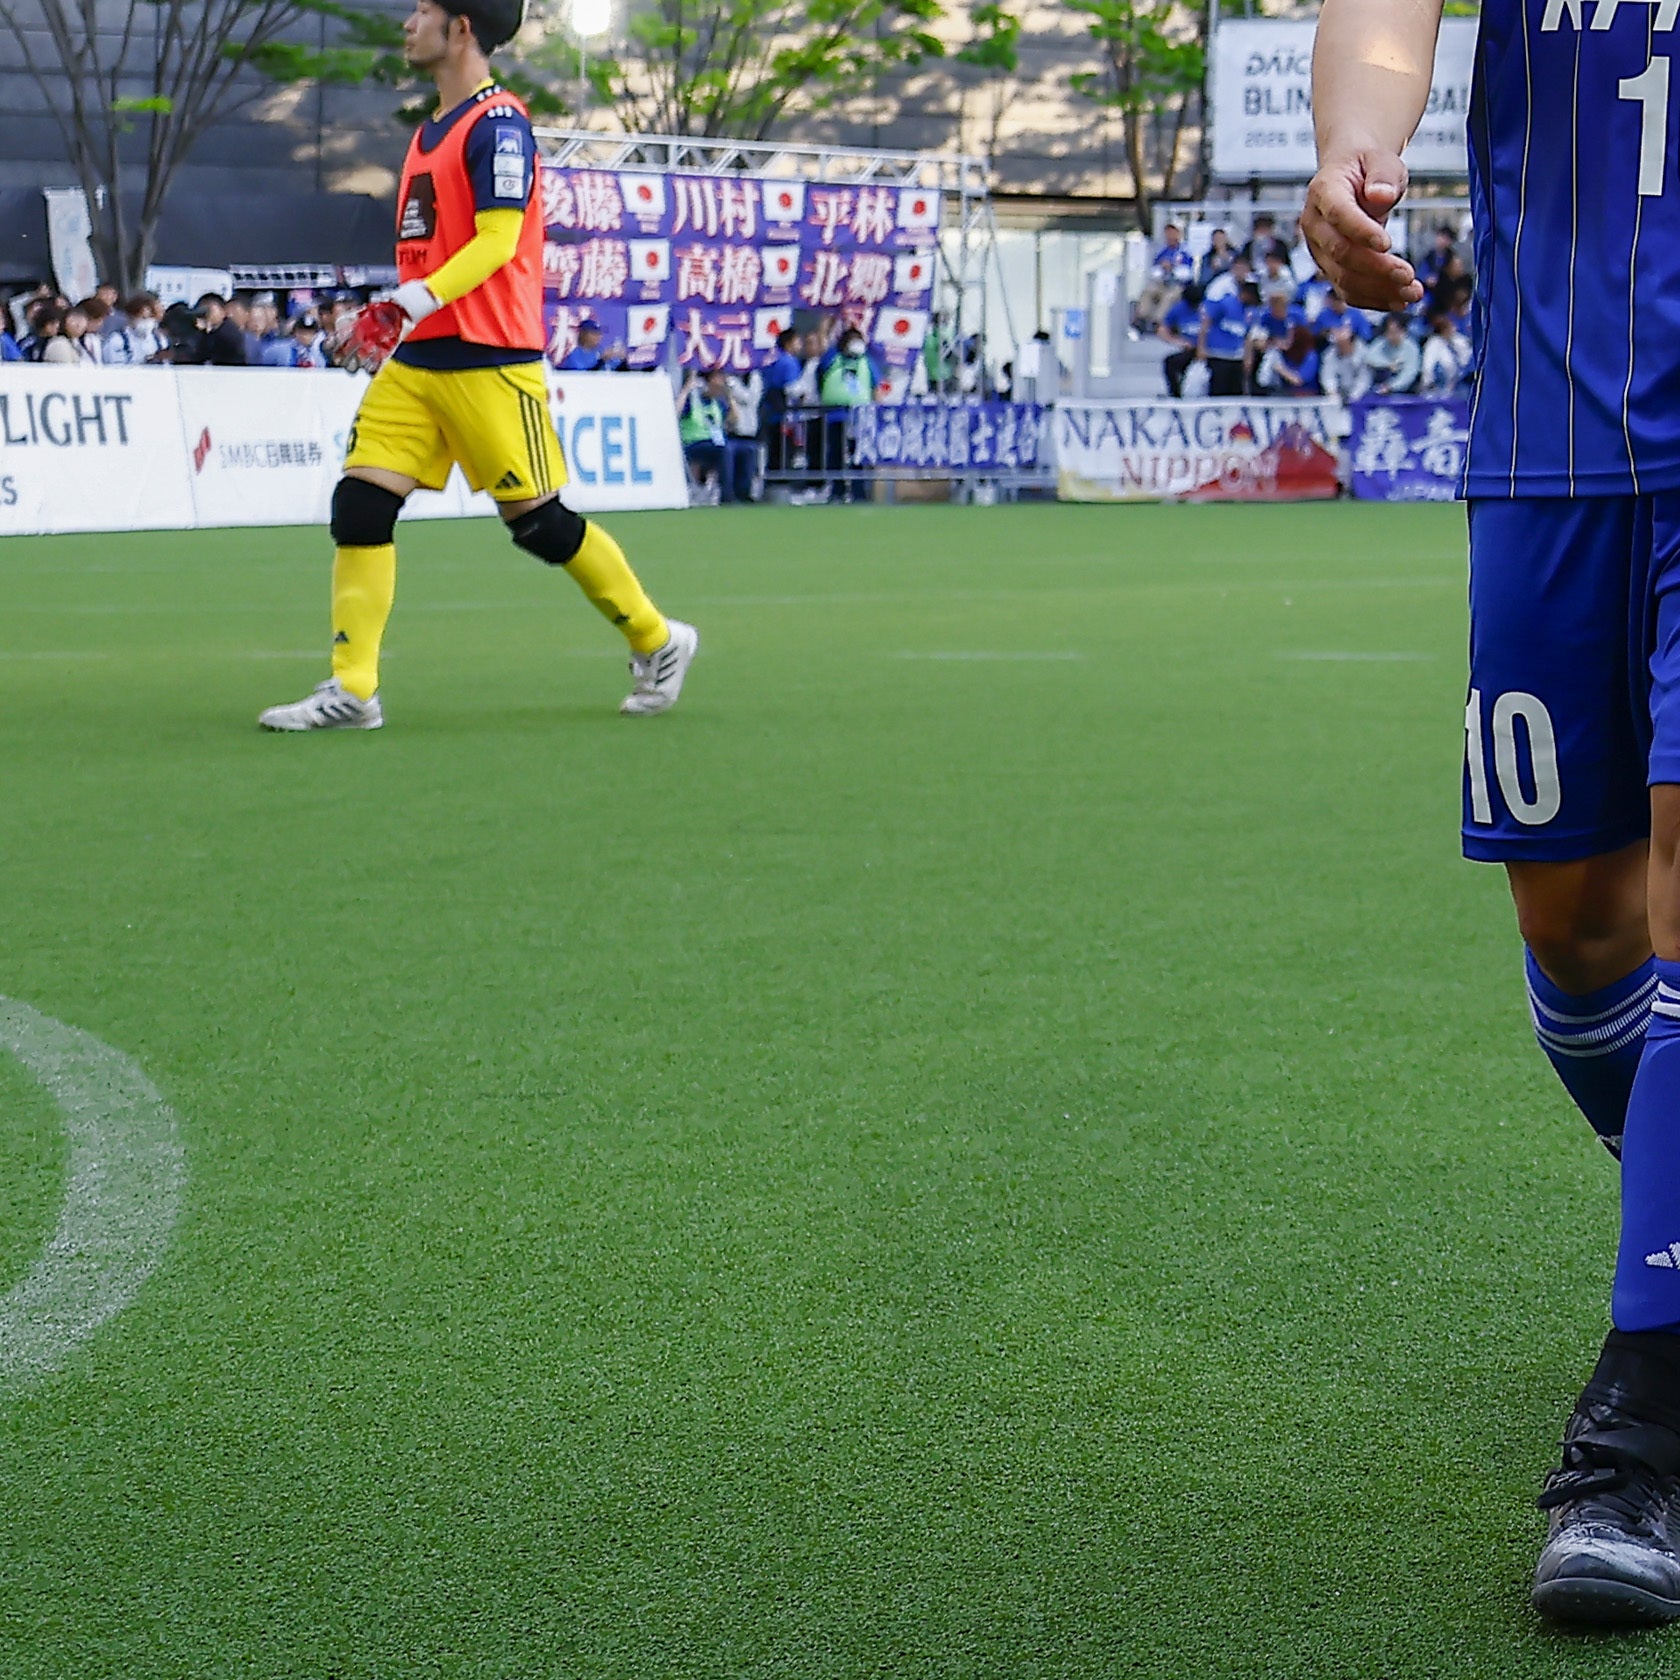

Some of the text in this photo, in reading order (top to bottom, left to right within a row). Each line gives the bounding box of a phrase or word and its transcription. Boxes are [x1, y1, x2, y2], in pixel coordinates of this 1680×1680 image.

[1244, 86, 1312, 117] BLIN
[672, 176, 760, 240] 川村
[809, 187, 896, 246] 平林
[1062, 406, 1334, 451] NAKAGAWA
[1120, 451, 1282, 494] NIPPON
[1464, 689, 1562, 825] 10
